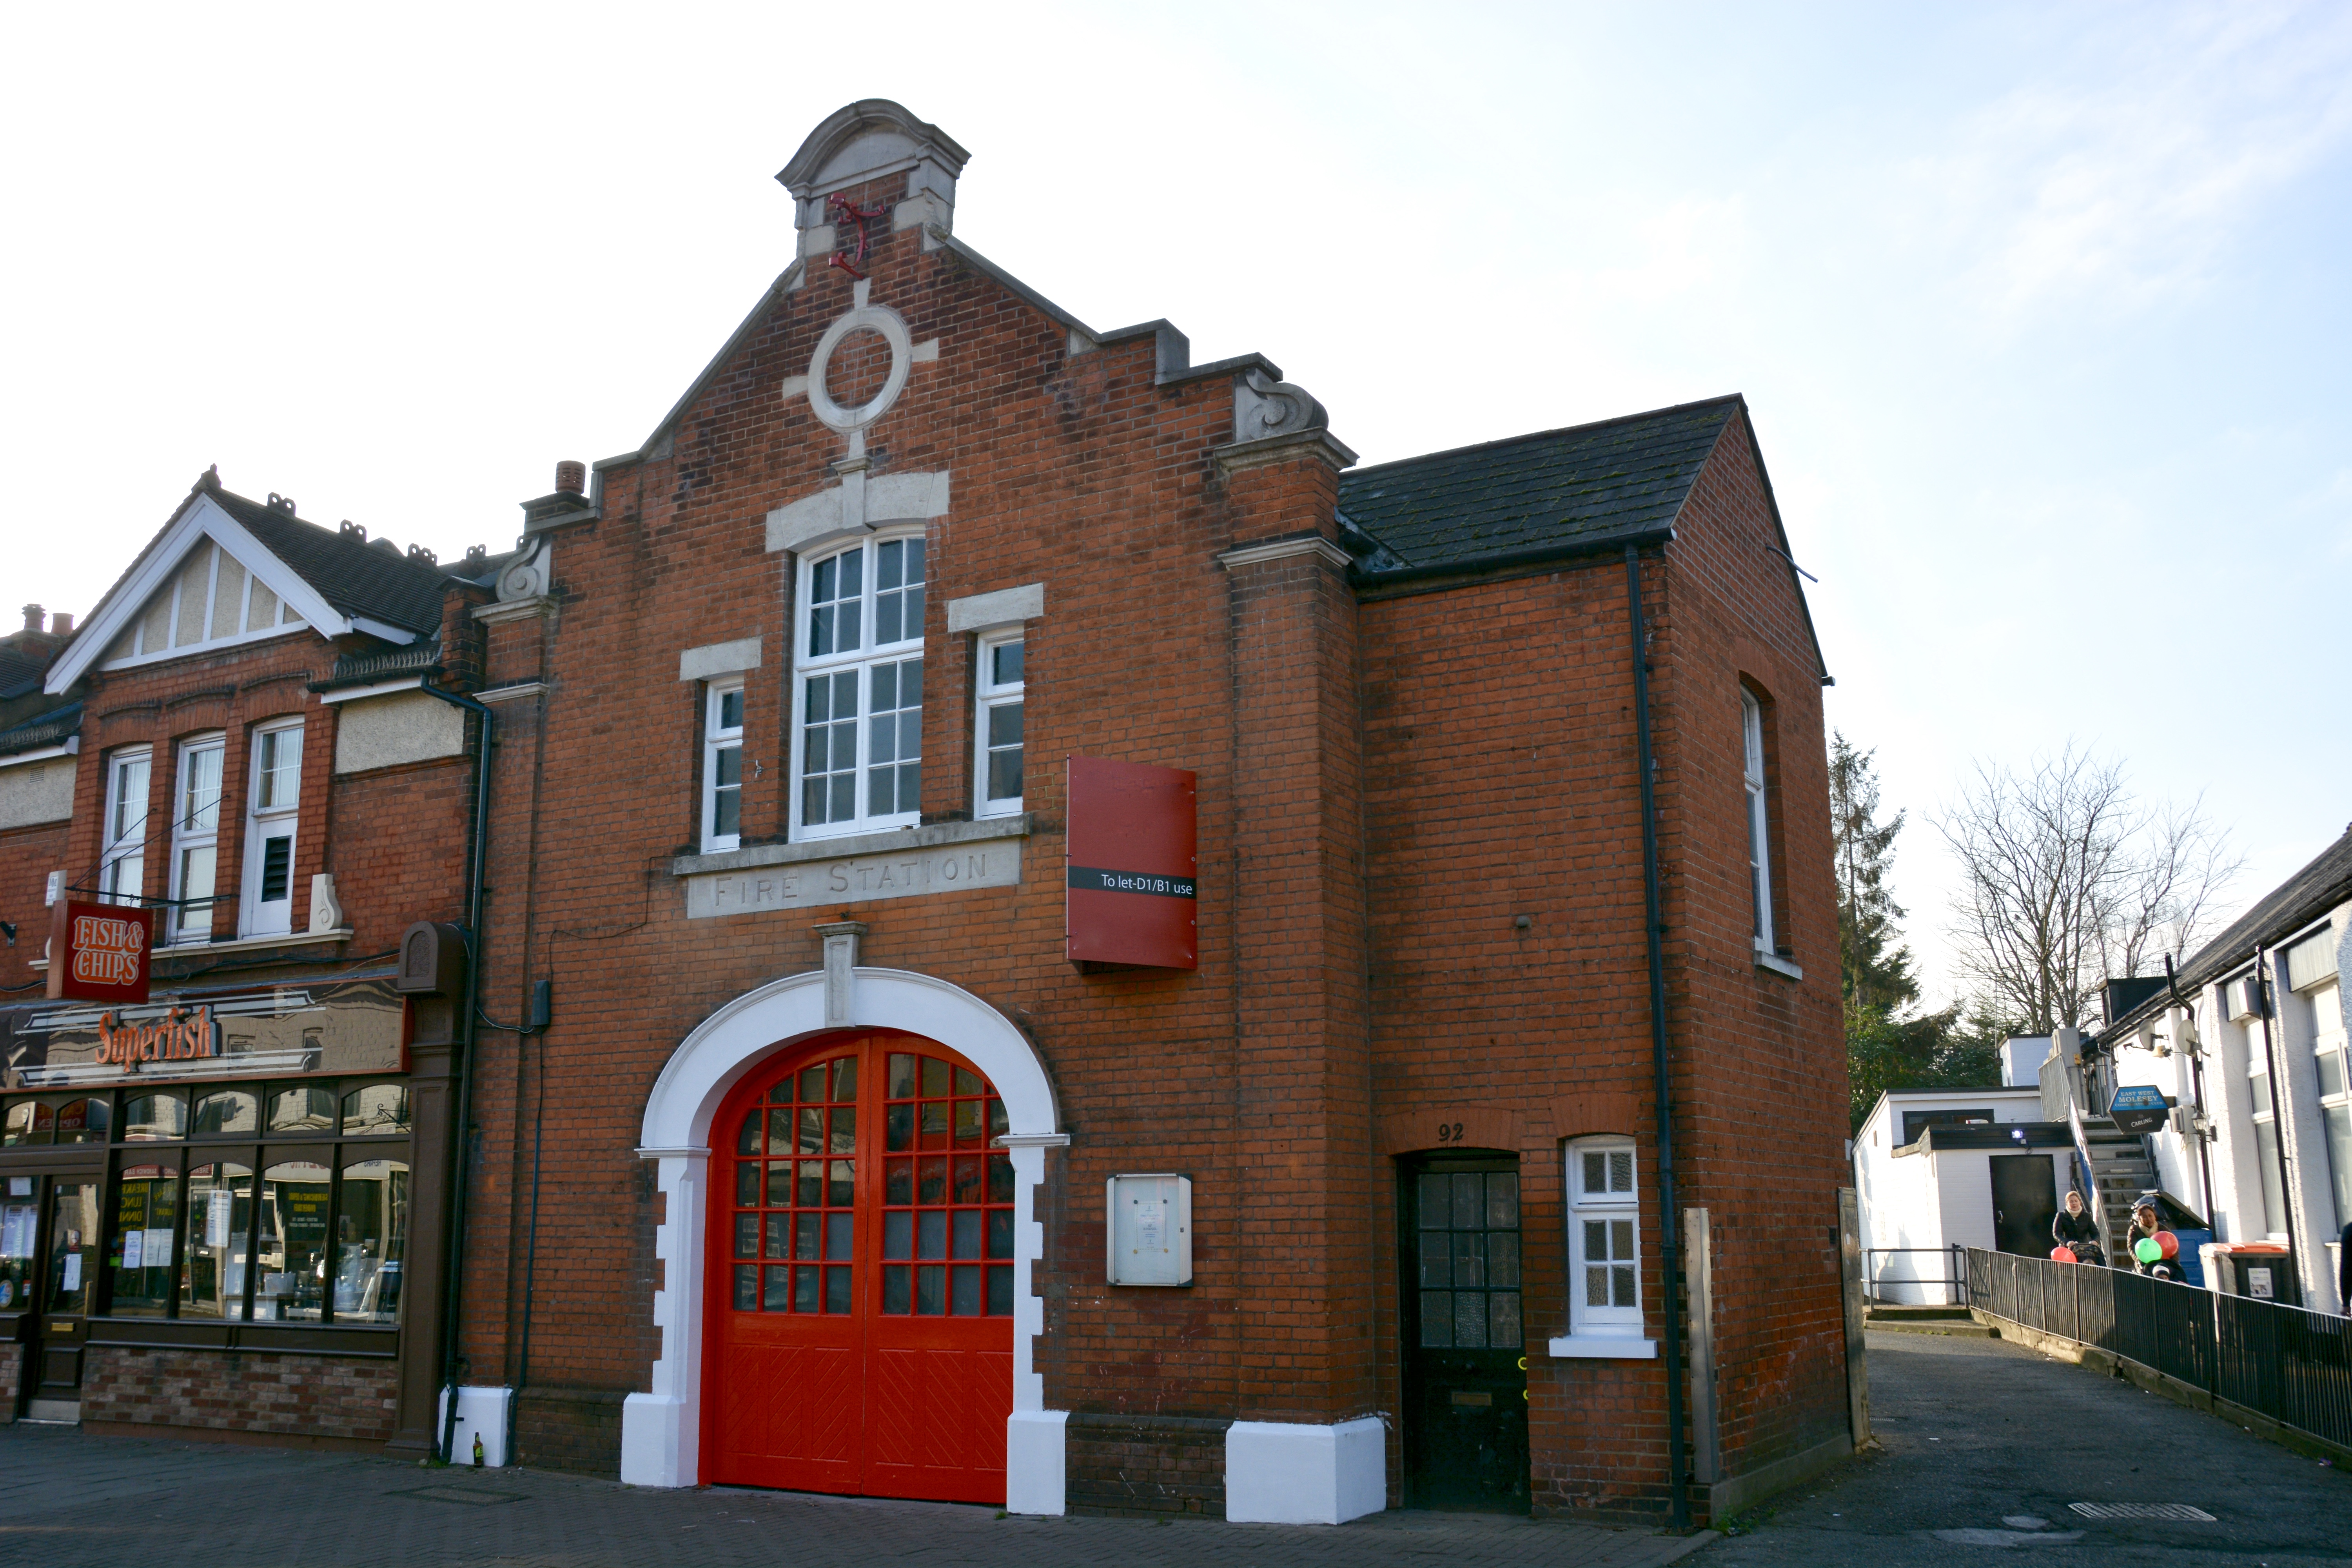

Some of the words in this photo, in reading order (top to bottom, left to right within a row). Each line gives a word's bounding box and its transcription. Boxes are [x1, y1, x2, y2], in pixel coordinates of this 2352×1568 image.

[715, 876, 798, 906] FIRE
[829, 854, 986, 892] STATION
[1101, 874, 1115, 886] To
[1118, 875, 1169, 892] let-D1/B1
[1174, 884, 1192, 895] use
[76, 917, 126, 950] FISH
[126, 922, 143, 951] &
[76, 951, 138, 982] CHIPS
[96, 1005, 214, 1073] Superfish
[1439, 1123, 1463, 1142] 92
[2131, 1117, 2152, 1127] CARLING
